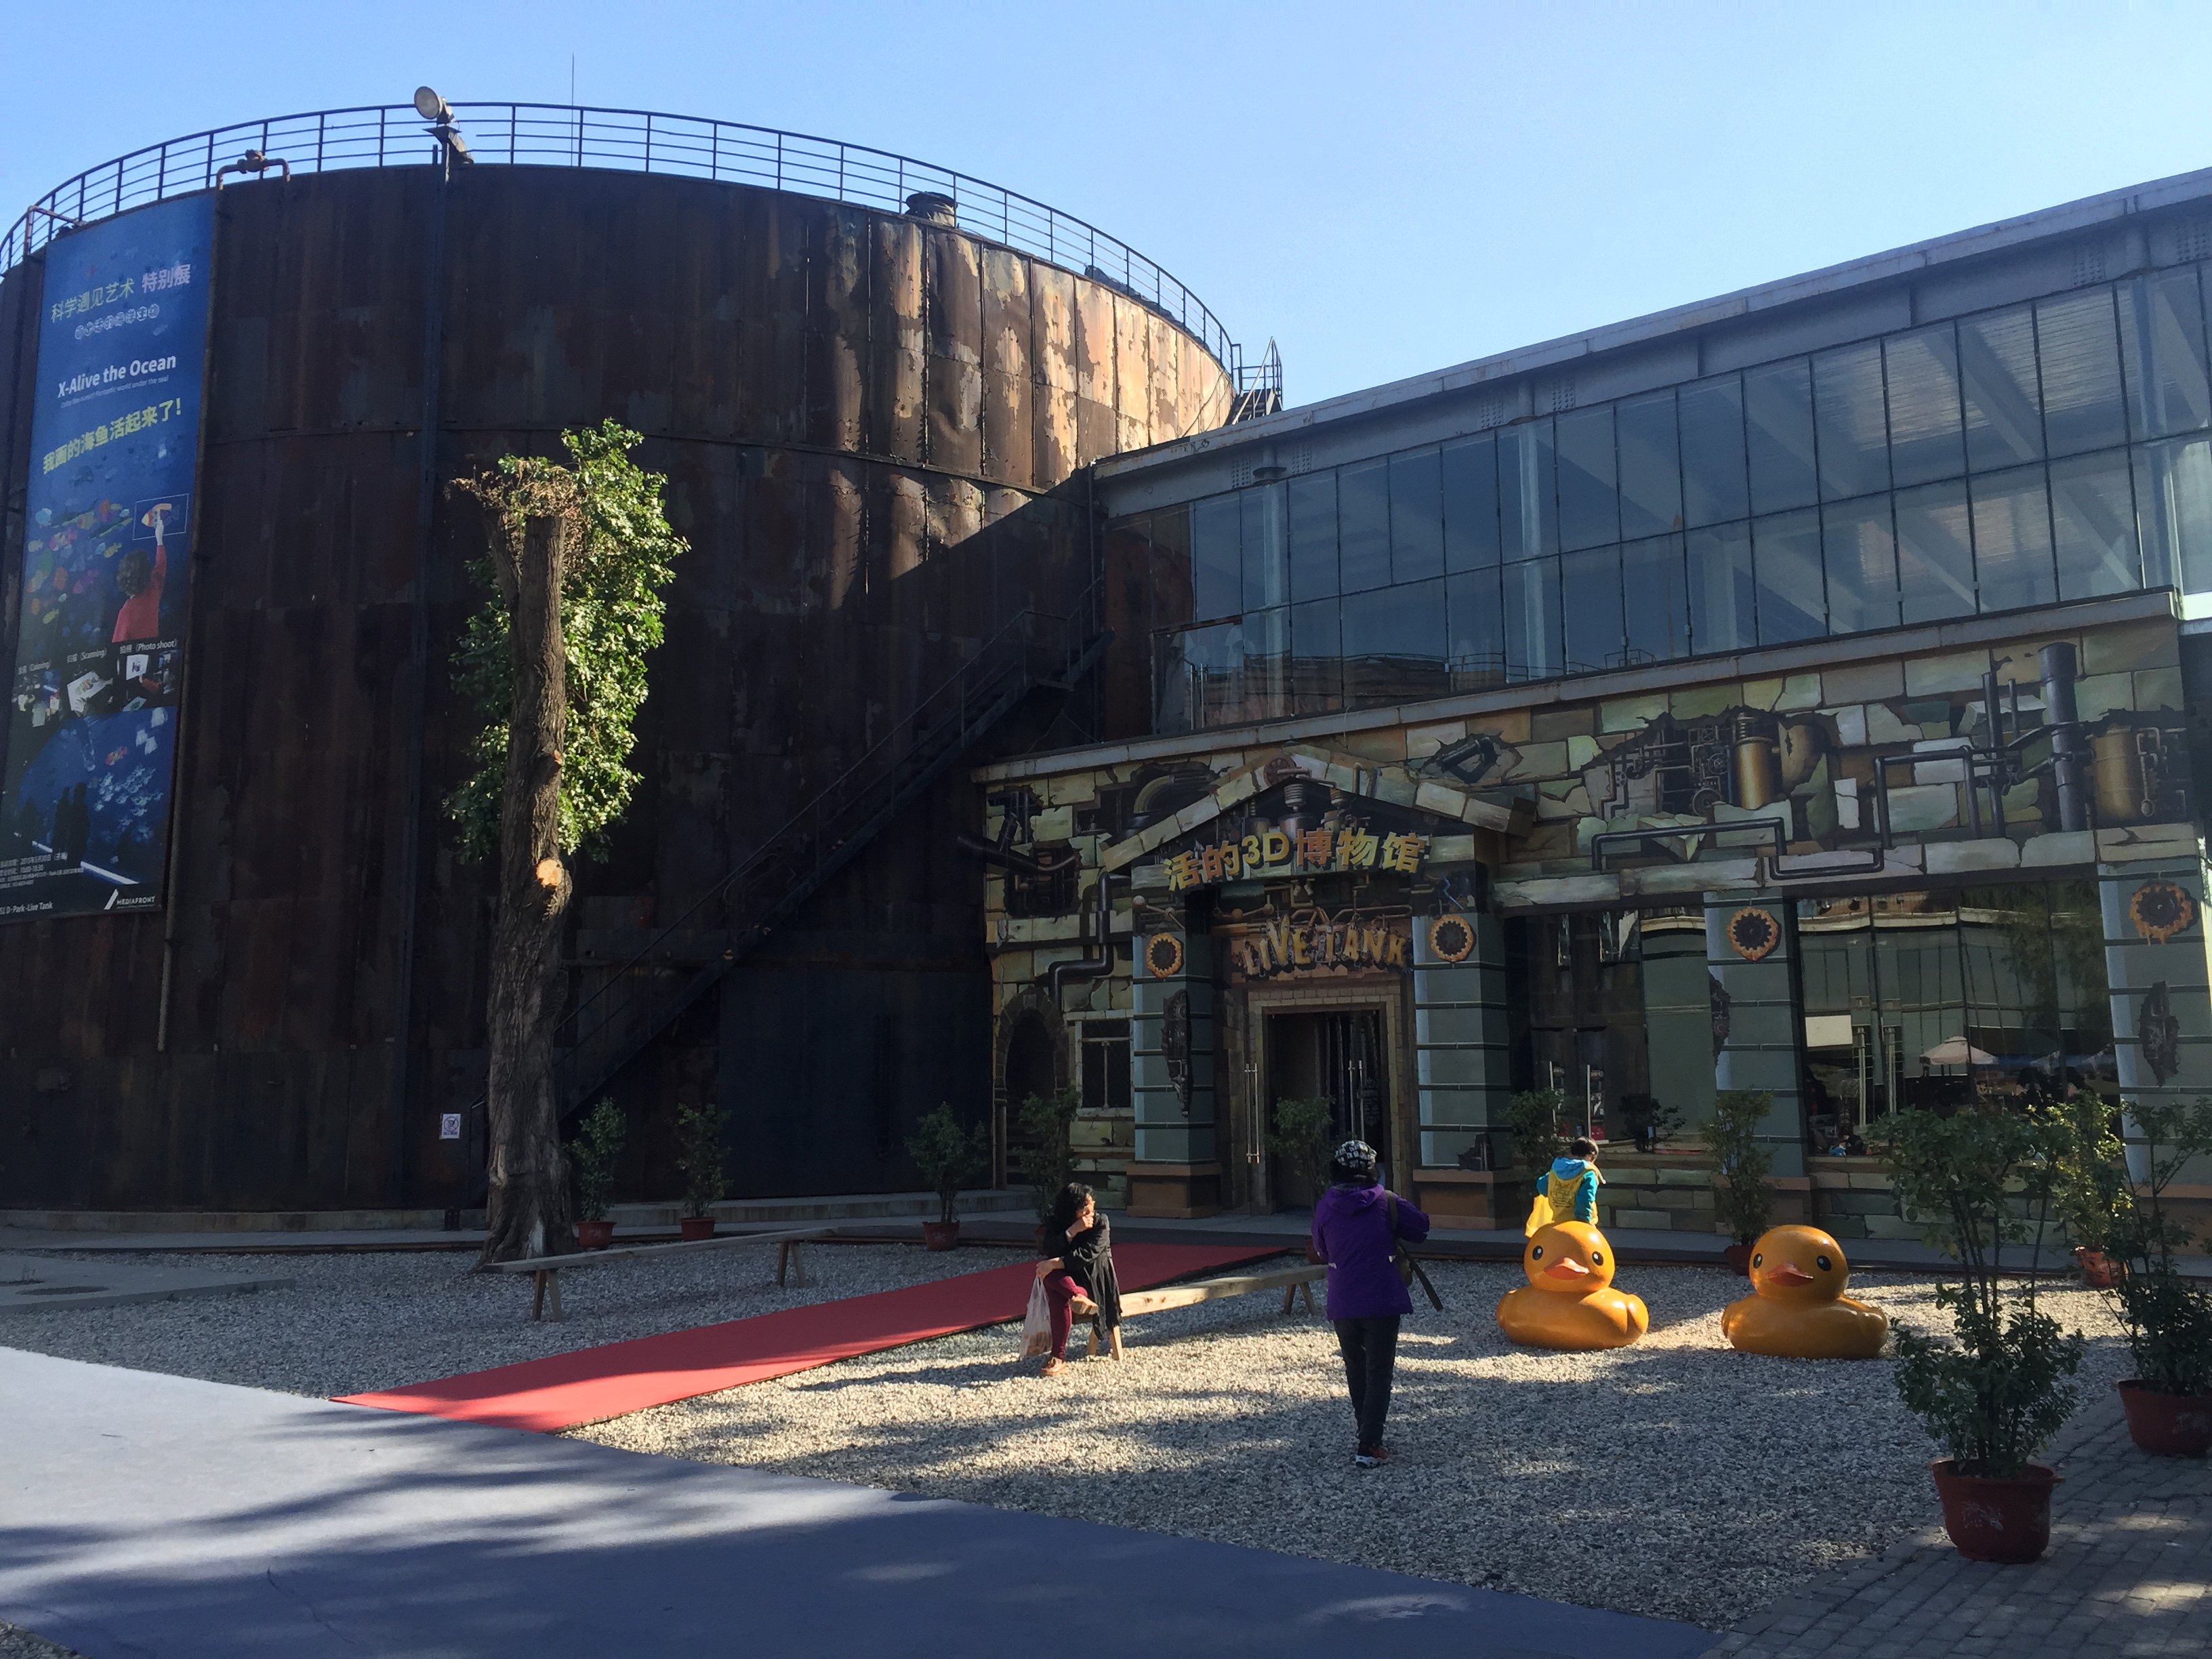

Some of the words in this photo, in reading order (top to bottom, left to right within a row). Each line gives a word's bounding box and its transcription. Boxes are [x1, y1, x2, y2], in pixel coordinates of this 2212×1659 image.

[51, 277, 134, 323] 科学遇见艺术
[142, 263, 191, 293] 特别展
[58, 374, 100, 398] X-Alive
[103, 365, 126, 384] the
[129, 355, 176, 376] Ocean
[1163, 827, 1426, 892] 活的3D博物馆
[117, 896, 156, 906] MEDIAFRONT
[1243, 914, 1313, 975] LIVE
